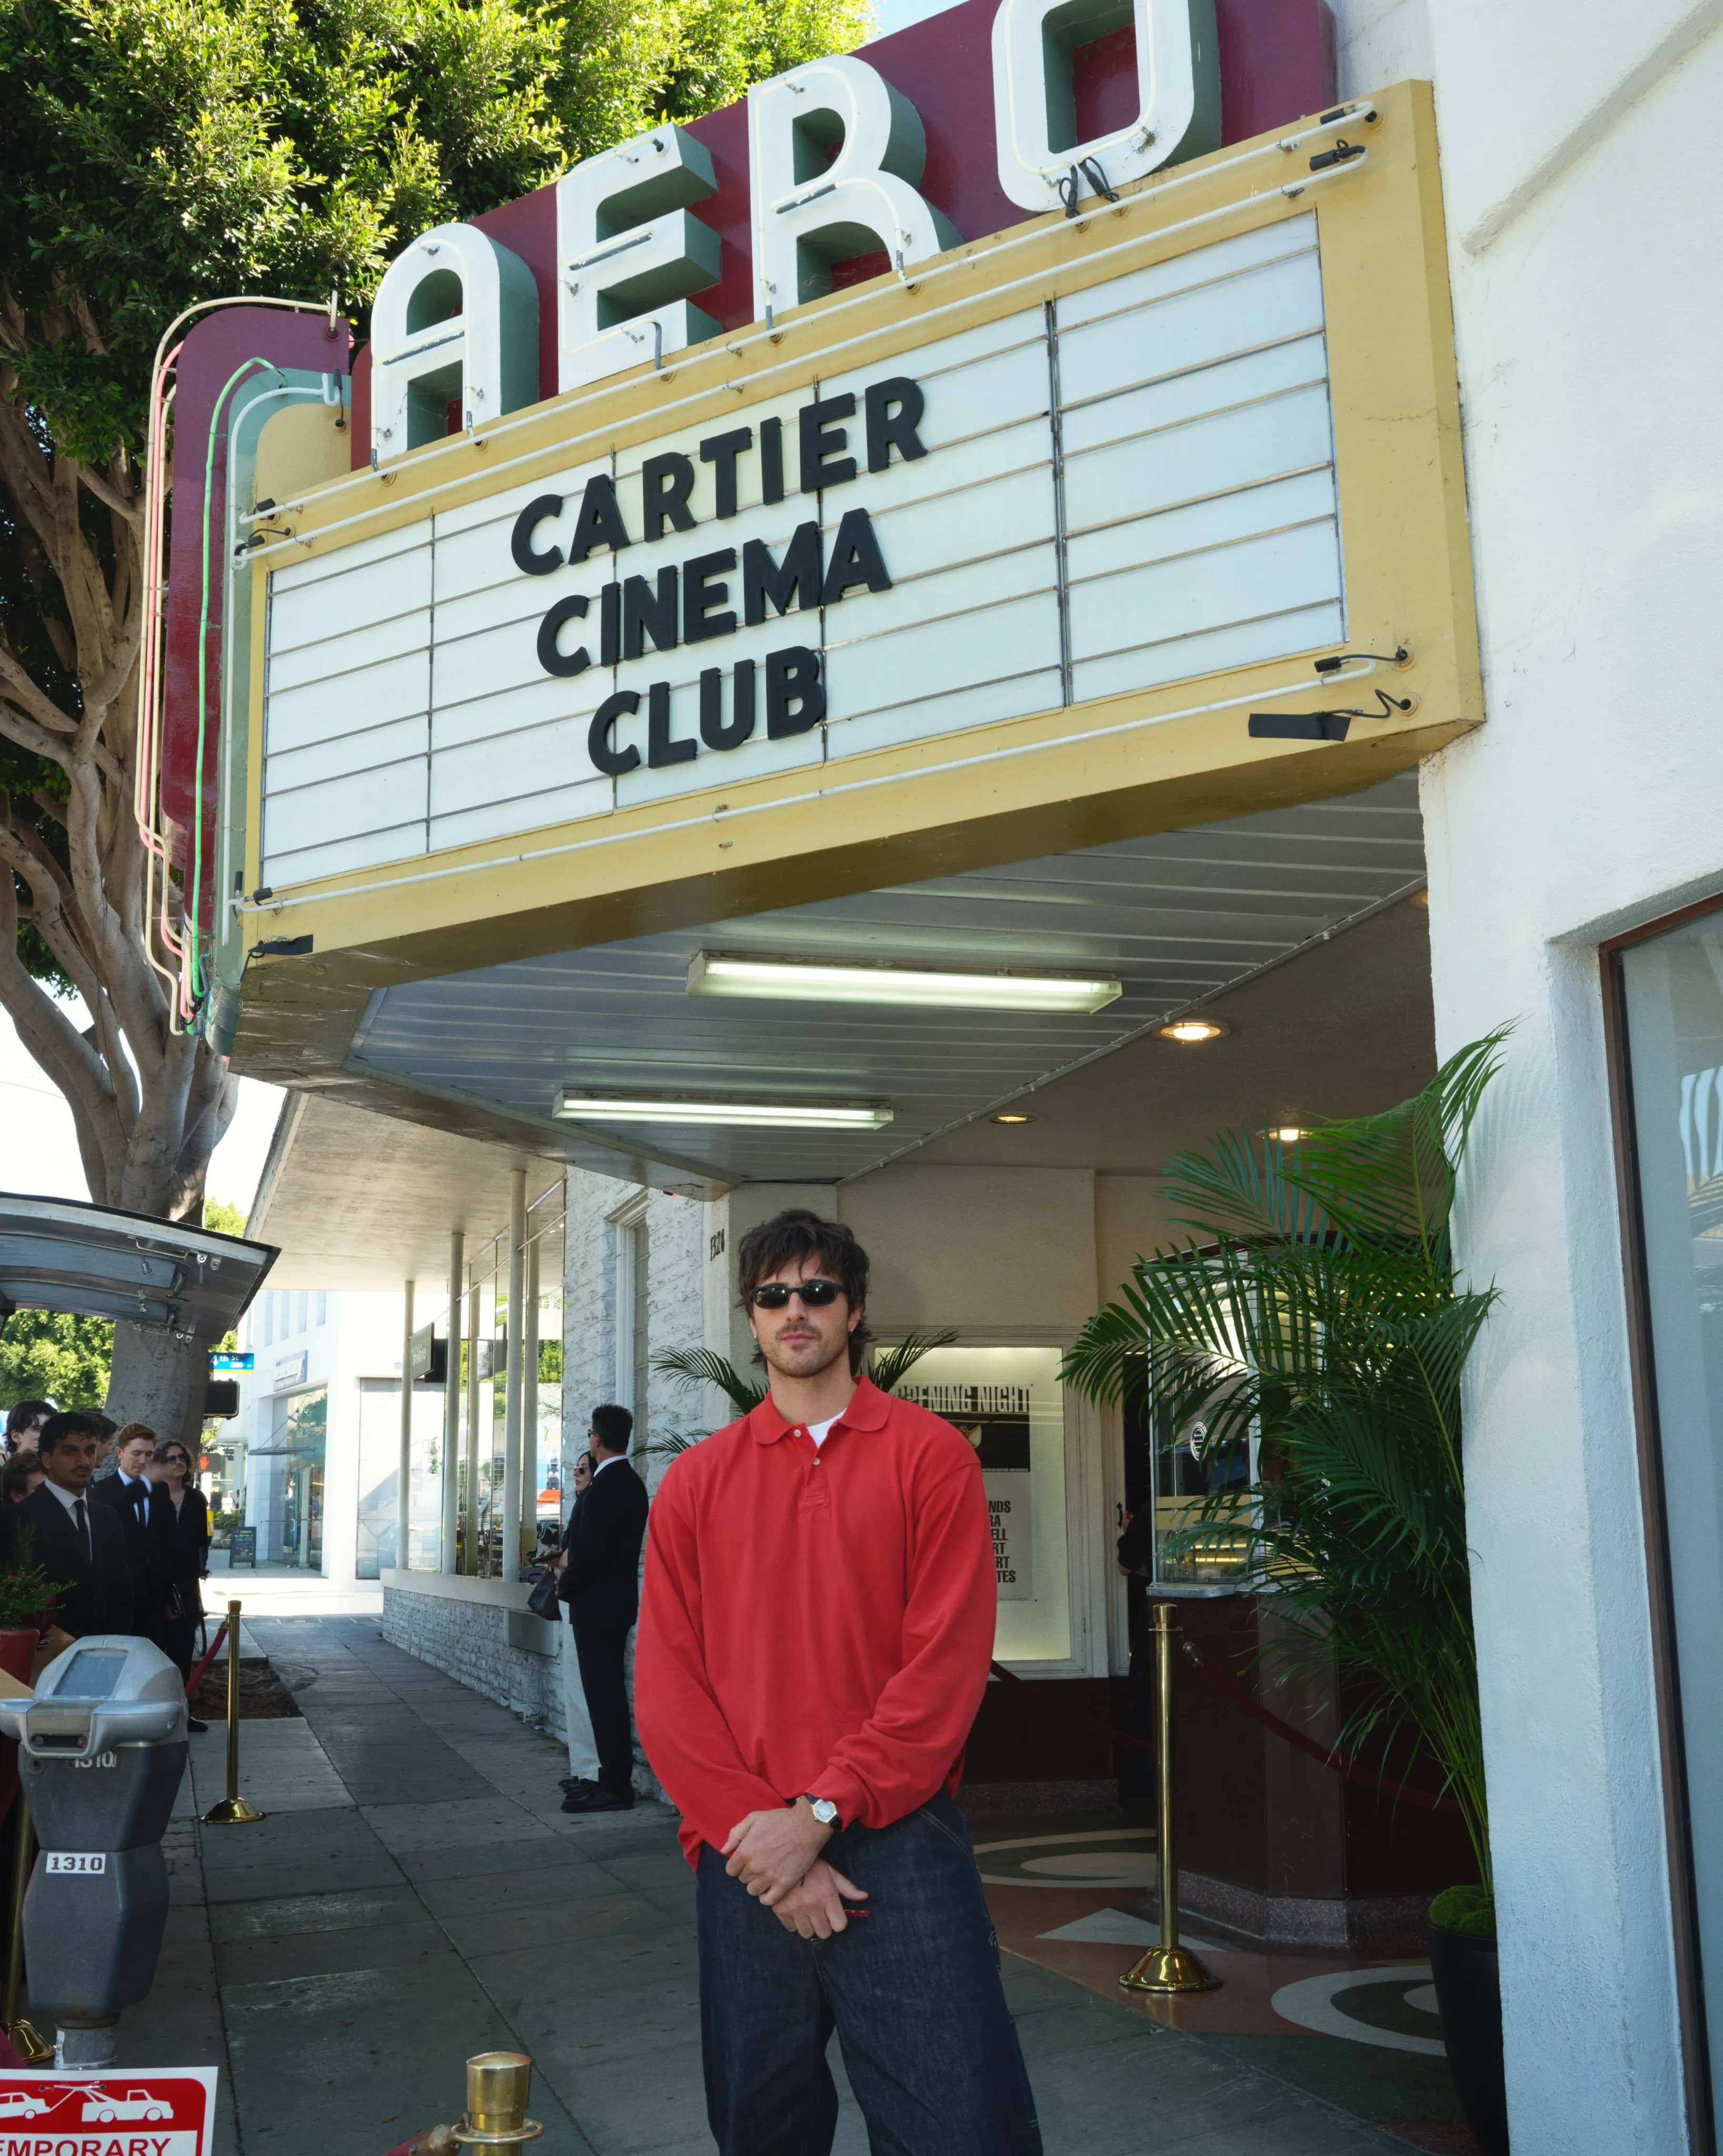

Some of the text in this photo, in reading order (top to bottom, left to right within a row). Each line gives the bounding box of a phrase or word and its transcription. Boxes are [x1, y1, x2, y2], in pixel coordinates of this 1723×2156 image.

[371, 0, 1206, 464] AERO
[511, 376, 928, 575] CARTIER
[536, 508, 892, 677] CINEMA
[587, 646, 826, 775] CLUB
[710, 1228, 724, 1261] 1328
[977, 1386, 1029, 1412] NIGHT
[988, 1500, 1011, 1513] NDS
[989, 1514, 1001, 1527] RA
[991, 1528, 1008, 1541] ELL
[992, 1542, 1005, 1554] RT
[993, 1556, 1010, 1569] RT
[996, 1570, 1016, 1583] TES
[51, 1856, 103, 1871] 1310
